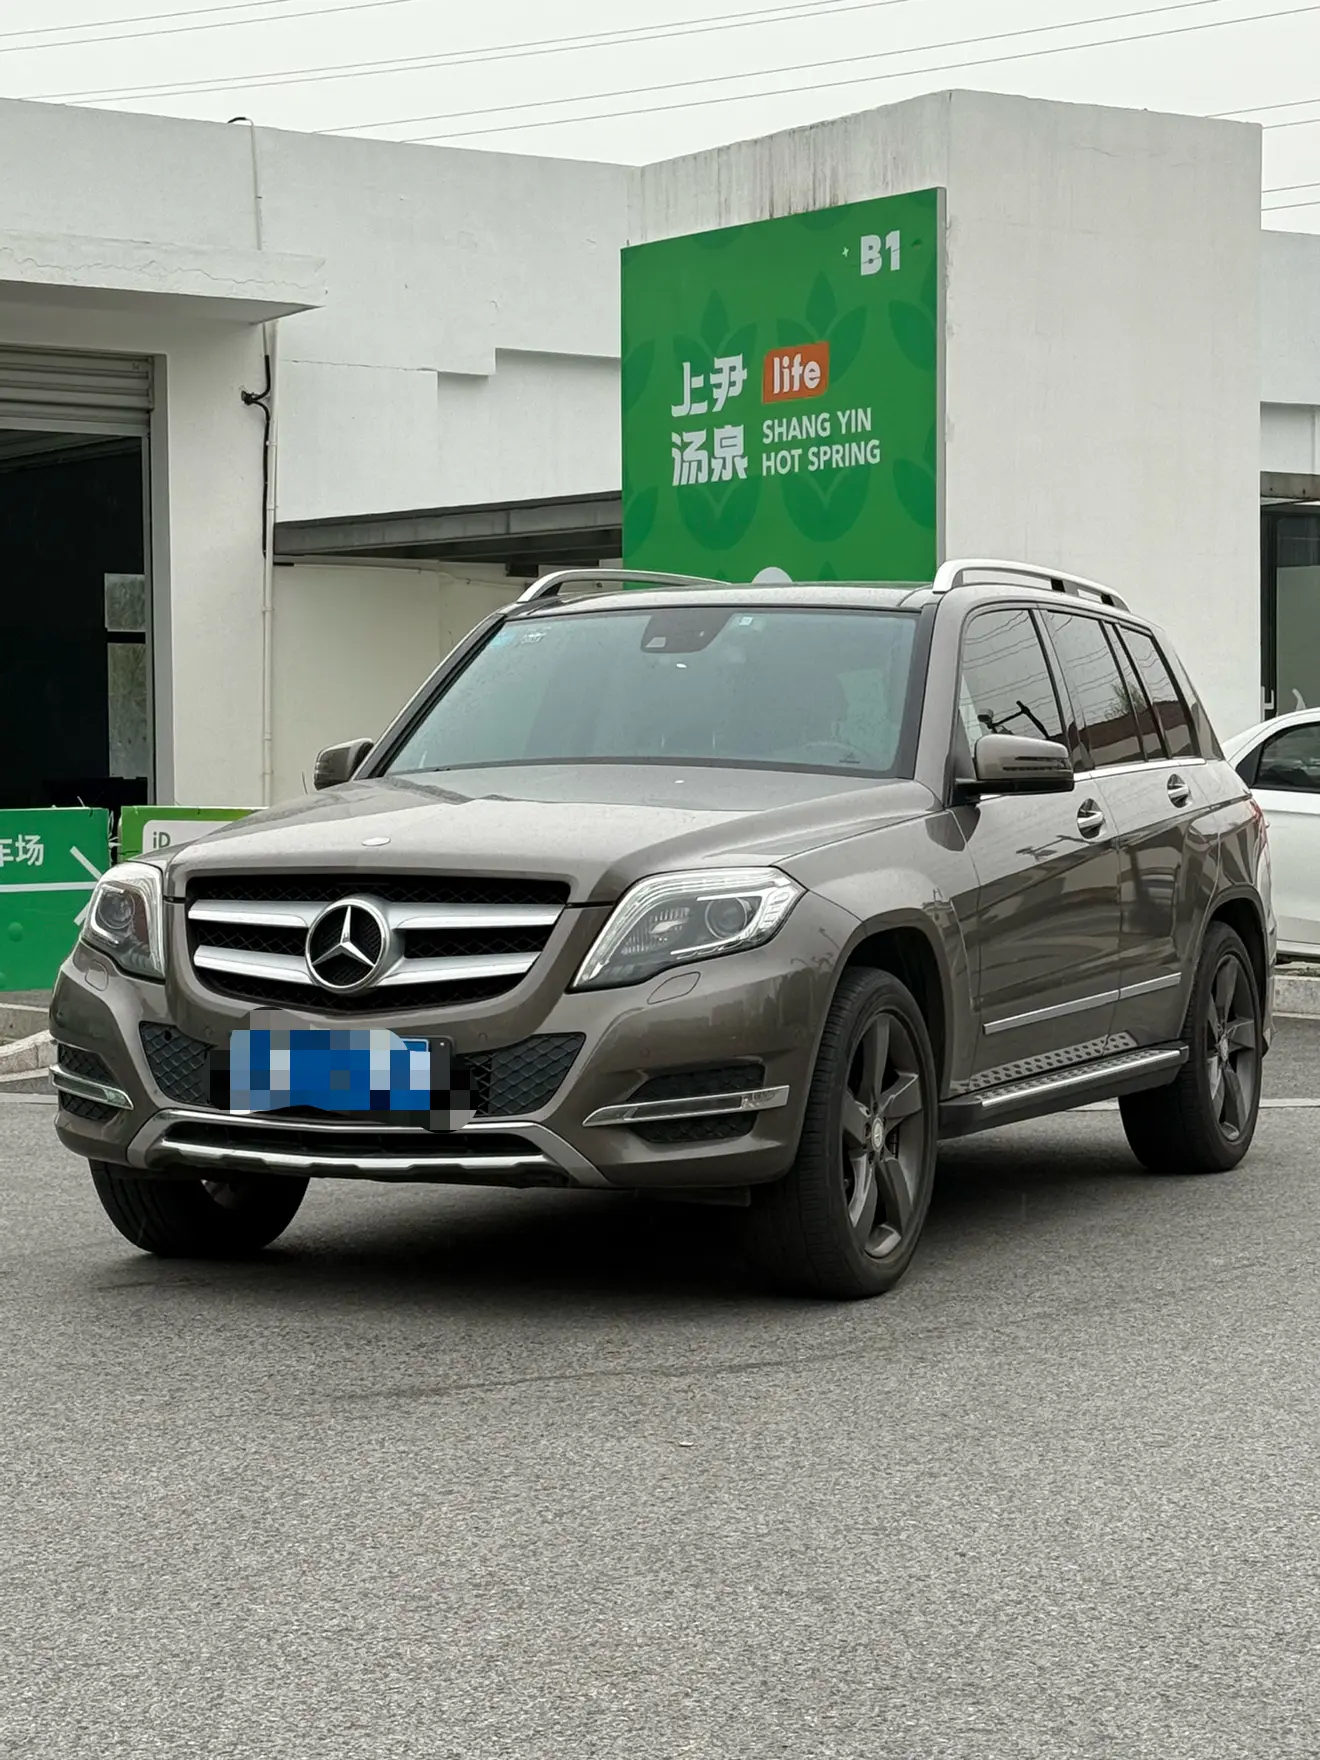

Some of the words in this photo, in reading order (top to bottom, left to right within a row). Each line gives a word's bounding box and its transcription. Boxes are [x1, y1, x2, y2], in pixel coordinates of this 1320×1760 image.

[860, 229, 900, 276] B1
[671, 353, 748, 418] 上尹
[772, 353, 822, 394] life
[762, 412, 831, 445] SHANG
[836, 407, 872, 435] YIN
[671, 424, 749, 487] 汤泉
[762, 448, 802, 477] HOT
[807, 439, 881, 471] SPRING
